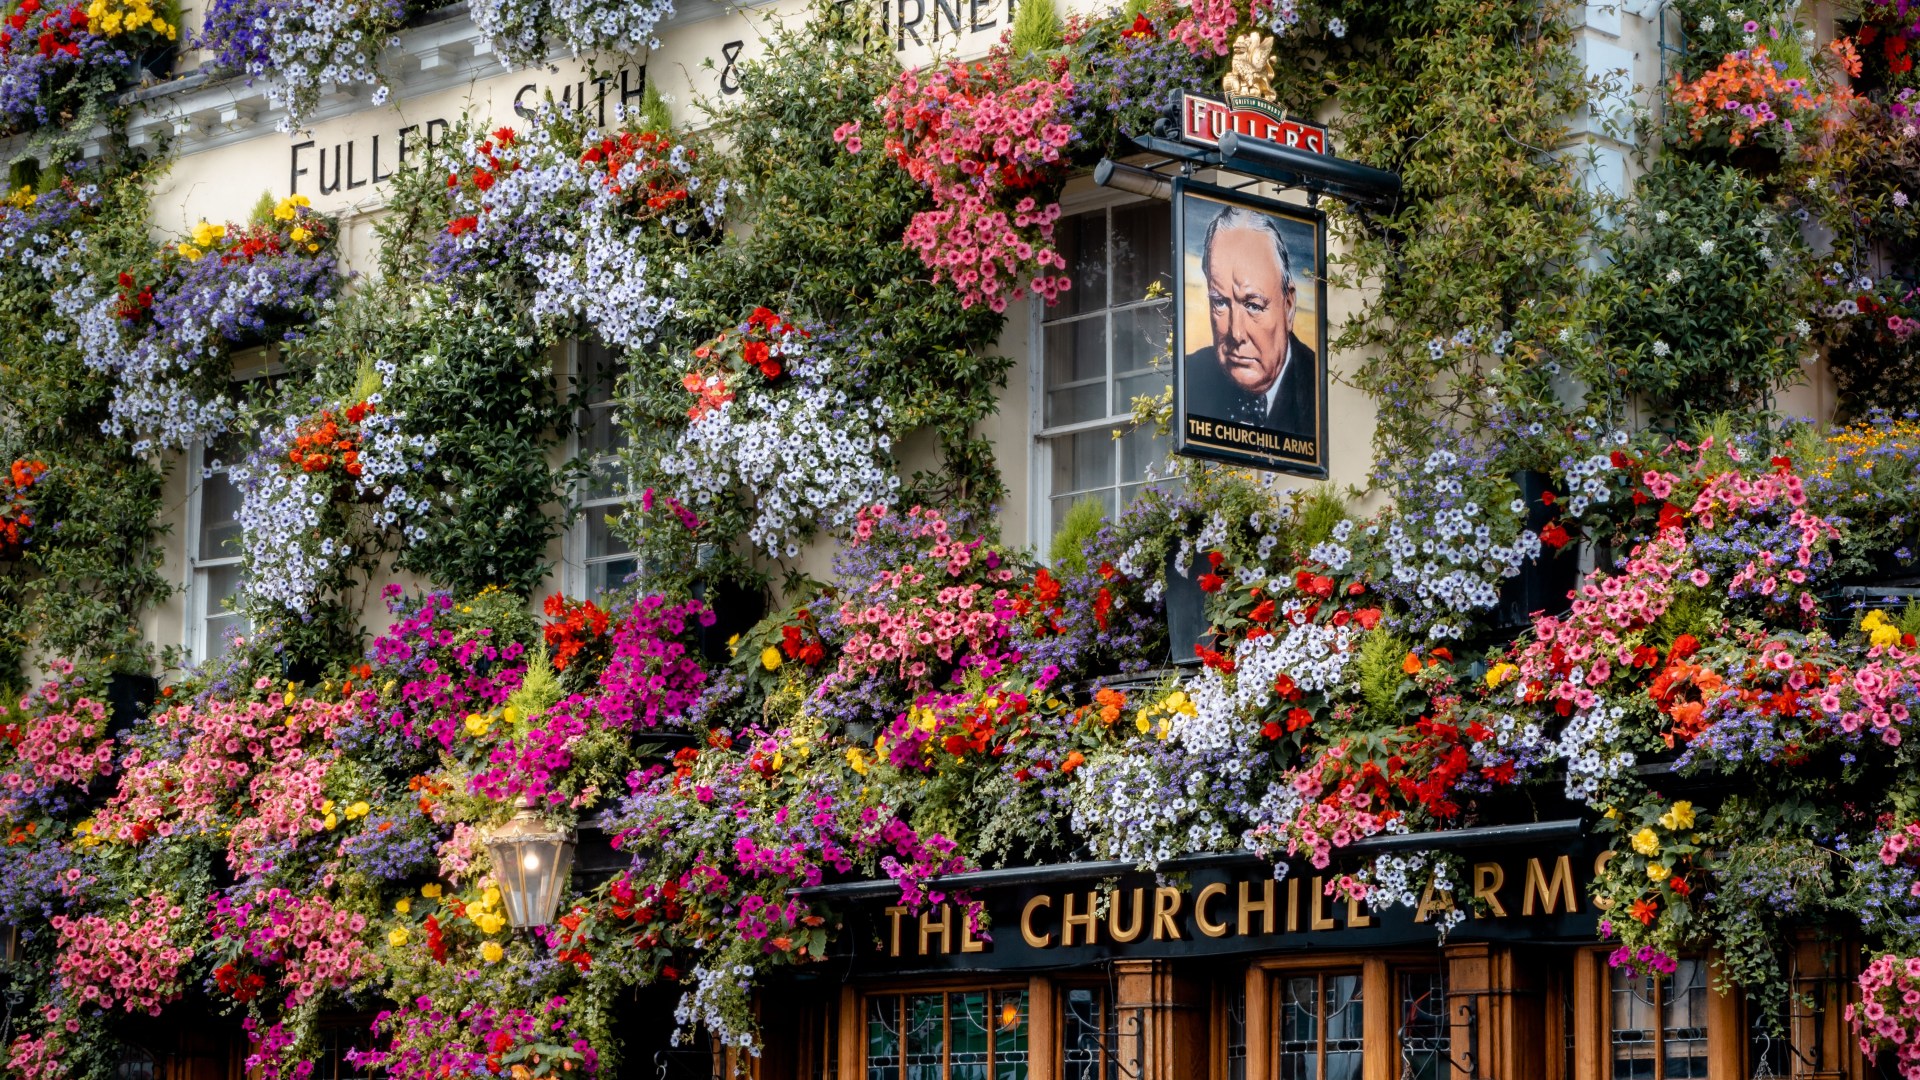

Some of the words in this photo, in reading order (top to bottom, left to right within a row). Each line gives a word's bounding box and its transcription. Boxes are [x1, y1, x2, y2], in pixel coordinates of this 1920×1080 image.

[514, 65, 646, 127] SITH
[720, 40, 744, 95] &
[1193, 100, 1319, 154] FULLER'S
[1189, 419, 1212, 437] THE
[1215, 424, 1281, 450] CHURCHILL
[1283, 437, 1315, 456] ARMS
[885, 900, 986, 957] THE
[1021, 874, 1370, 948] CHURCHILL
